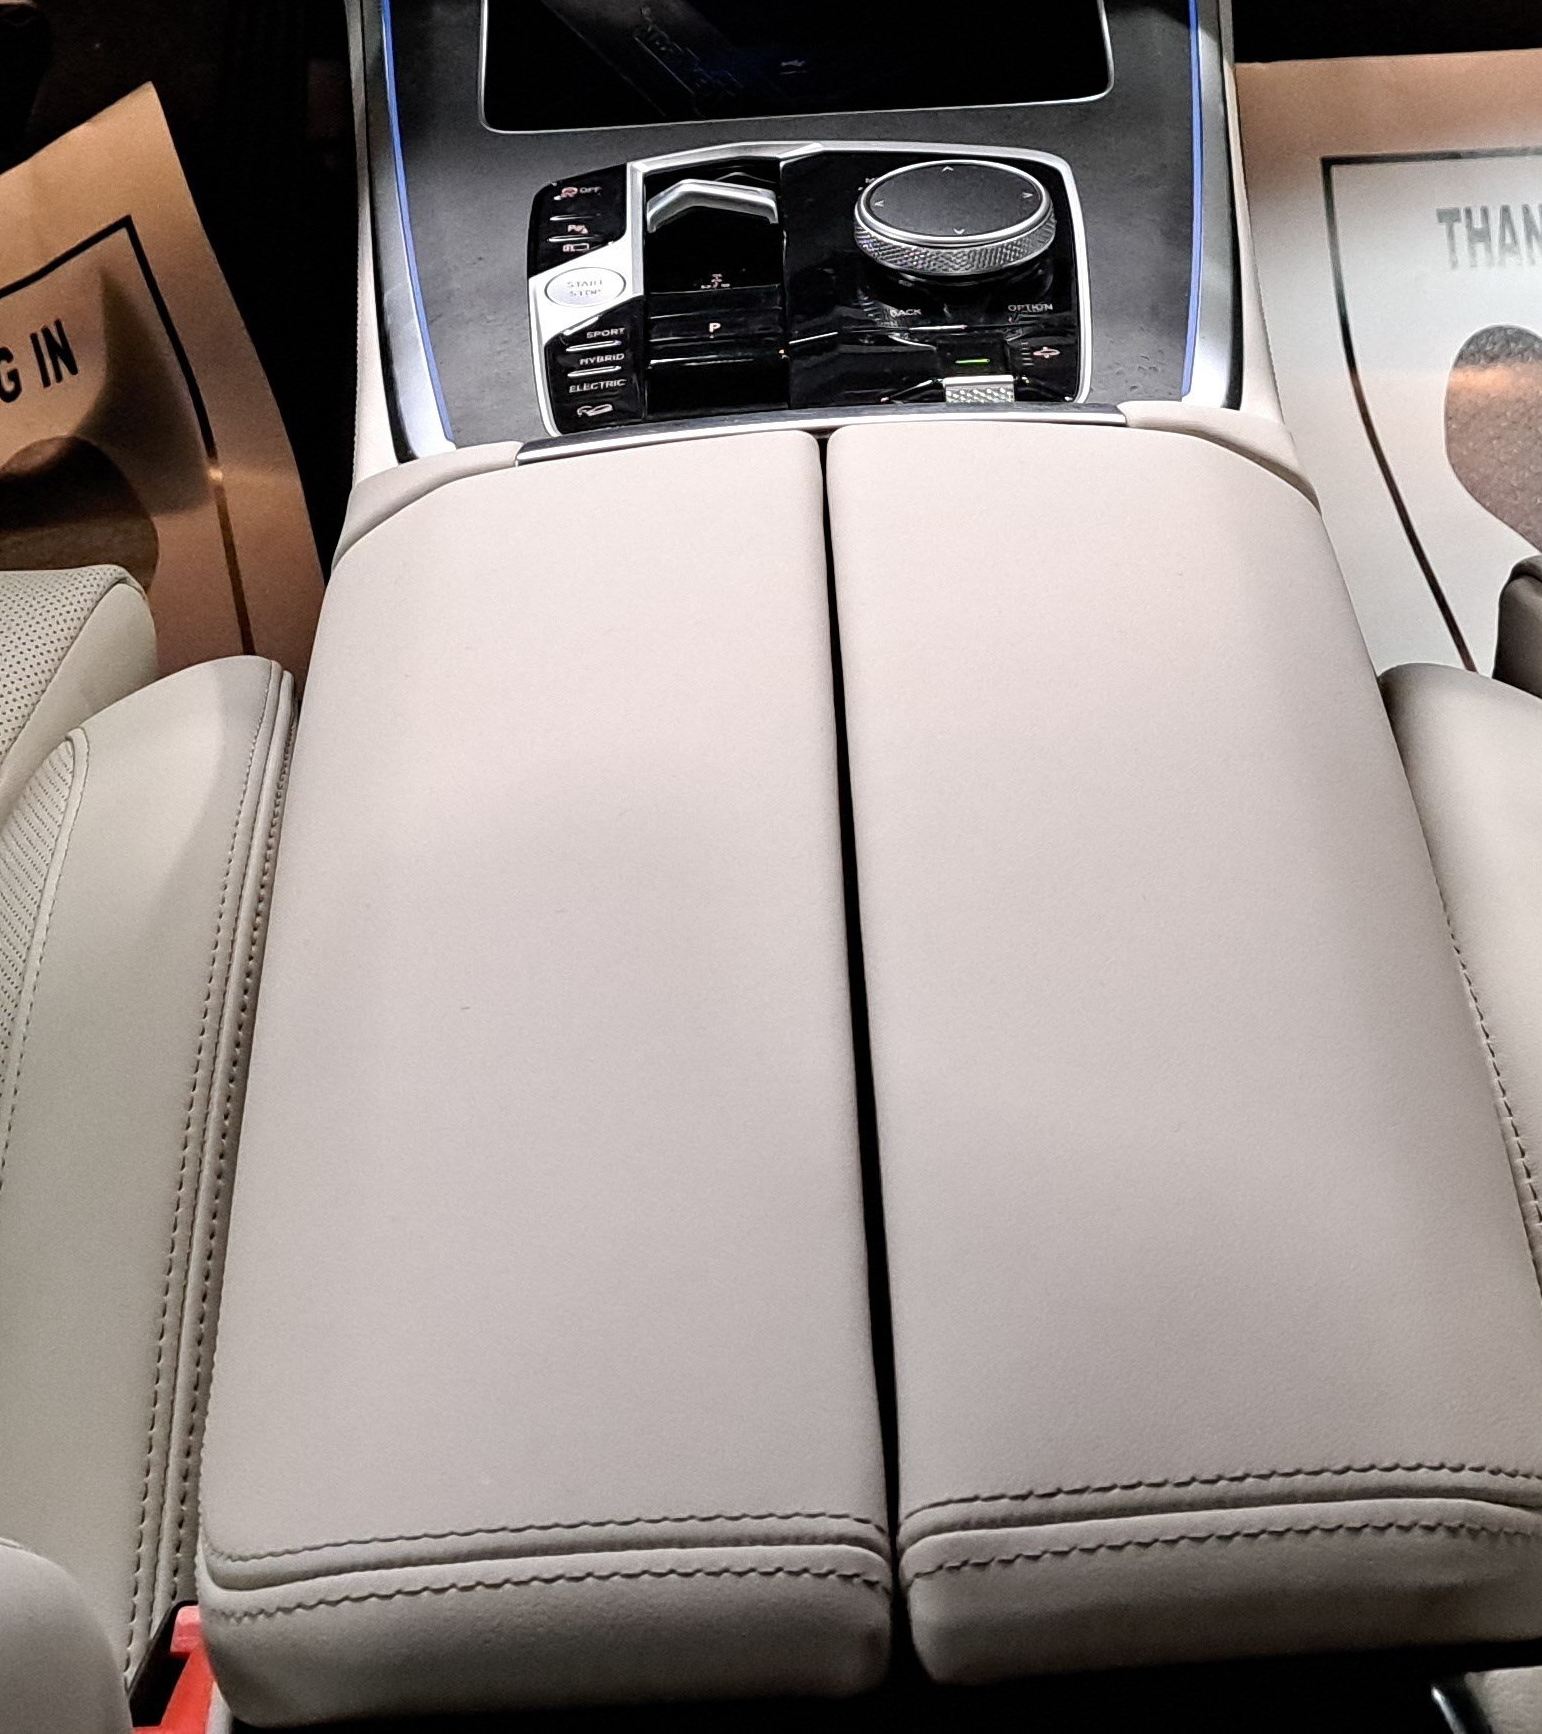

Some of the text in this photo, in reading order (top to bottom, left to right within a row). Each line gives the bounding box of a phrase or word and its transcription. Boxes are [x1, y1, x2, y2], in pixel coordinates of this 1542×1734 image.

[580, 186, 602, 194] OFF
[890, 309, 922, 317] BACK
[1008, 303, 1053, 312] OPTION
[709, 322, 721, 333] P
[586, 328, 625, 339] SPORT
[30, 318, 79, 389] IN
[579, 353, 625, 366] HYBRID
[569, 379, 627, 393] ELECTRIC
